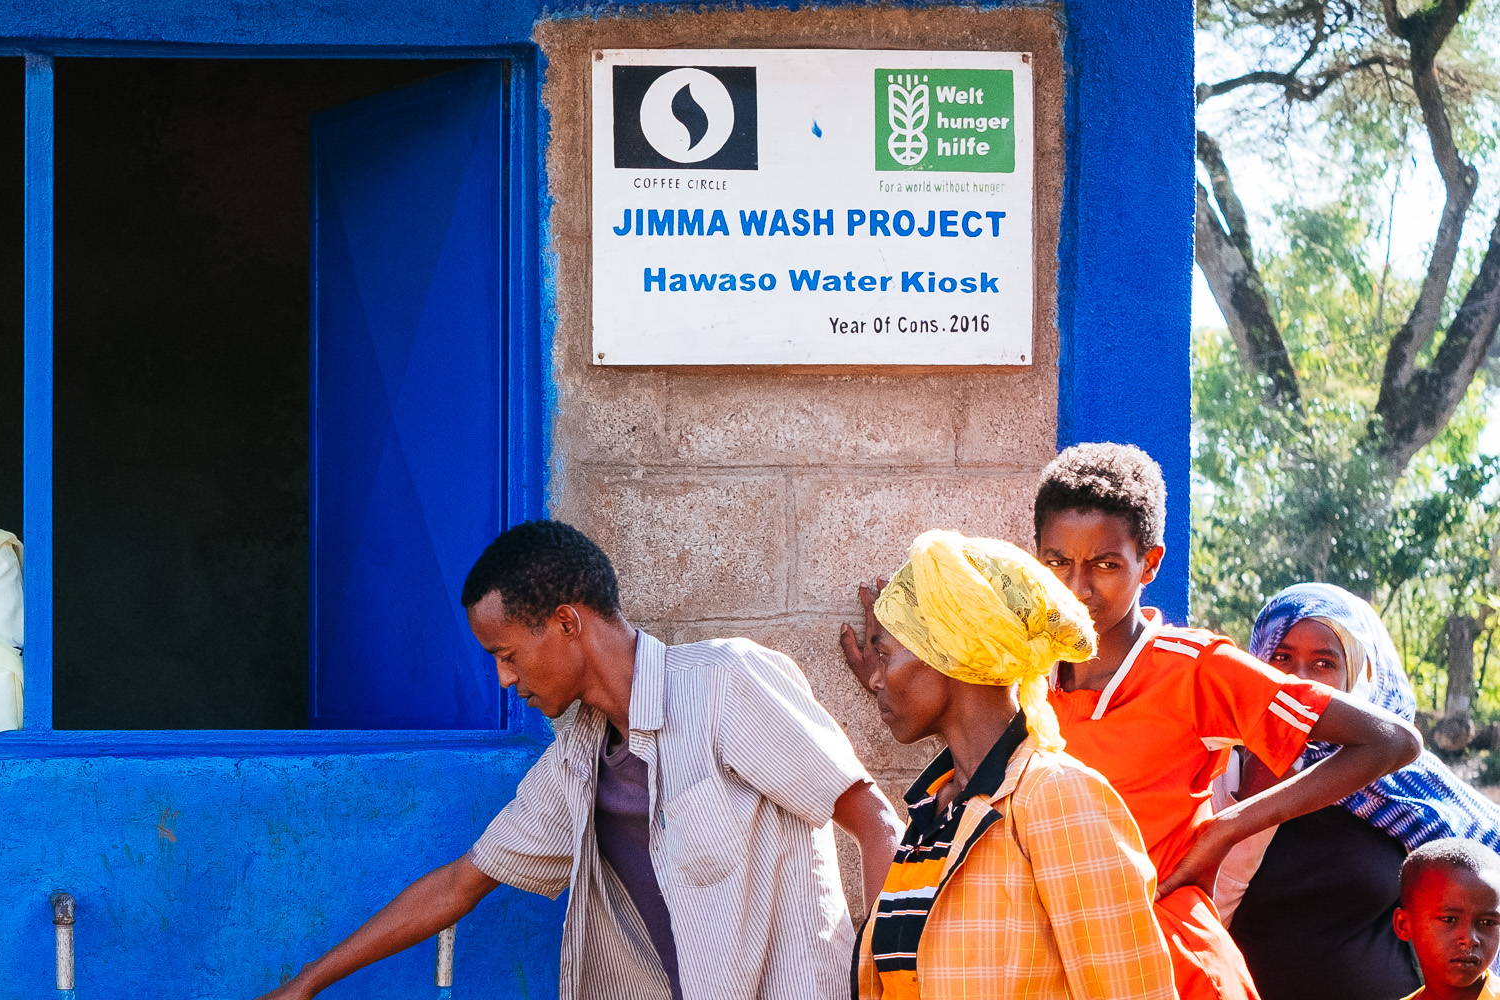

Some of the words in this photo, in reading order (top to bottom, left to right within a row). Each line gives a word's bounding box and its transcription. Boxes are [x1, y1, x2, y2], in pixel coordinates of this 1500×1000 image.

[936, 86, 984, 105] Welt
[937, 111, 1010, 132] hunger
[937, 136, 990, 156] hilfe
[633, 177, 680, 189] COFFEE
[687, 179, 727, 191] CIRCLE
[879, 180, 895, 193] For
[896, 183, 903, 193] a
[905, 180, 932, 193] world
[934, 180, 970, 193] without
[973, 181, 1005, 196] hunger
[612, 208, 731, 237] JIMMA
[739, 208, 835, 237] WASH
[847, 209, 1007, 239] PROJECT
[643, 267, 778, 293] Hawaso
[788, 269, 893, 293] Water
[901, 271, 1000, 294] Kiosk
[828, 316, 867, 335] Year
[949, 313, 990, 333] 2016
